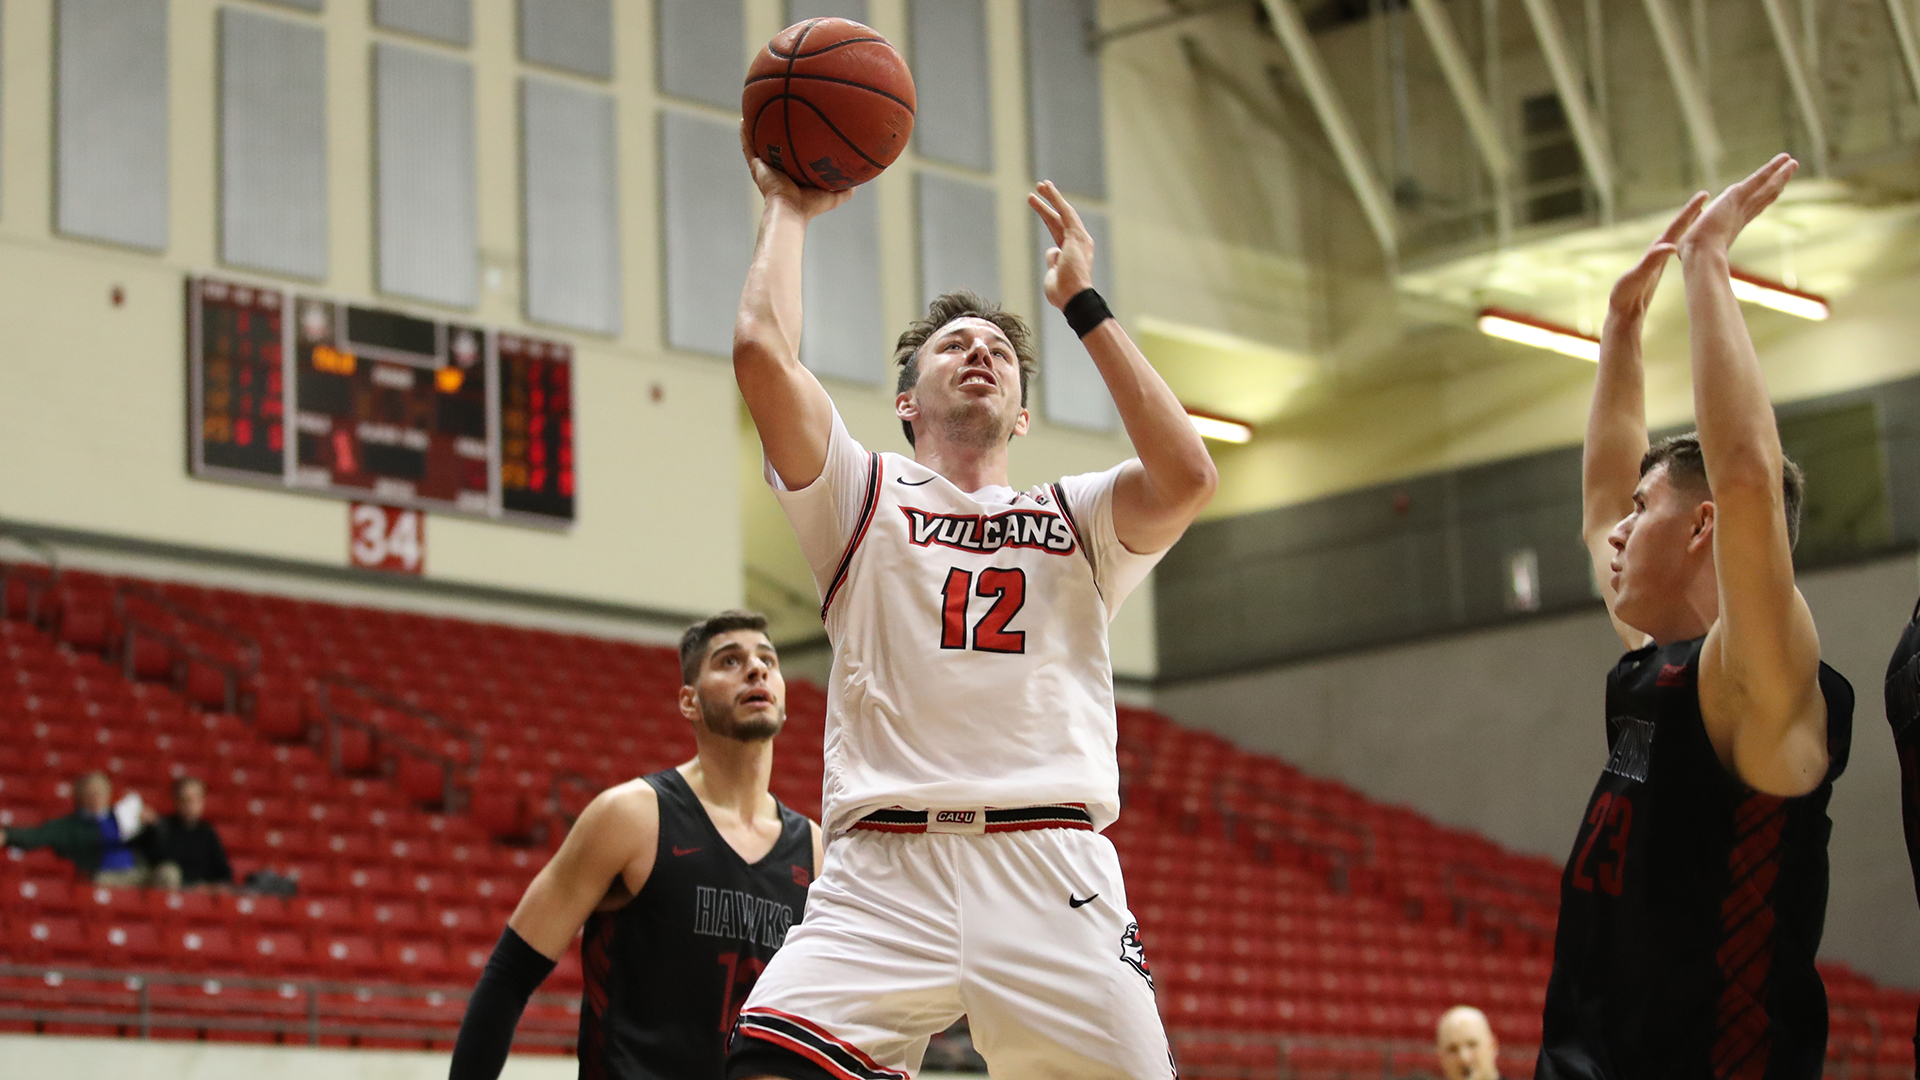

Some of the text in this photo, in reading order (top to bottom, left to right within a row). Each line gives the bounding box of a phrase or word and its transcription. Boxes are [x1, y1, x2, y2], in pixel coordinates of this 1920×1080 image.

[353, 504, 421, 570] 34
[907, 509, 1075, 553] VULCANS
[940, 567, 1026, 654] 12
[1572, 791, 1633, 896] 23
[694, 886, 793, 950] HAWKS
